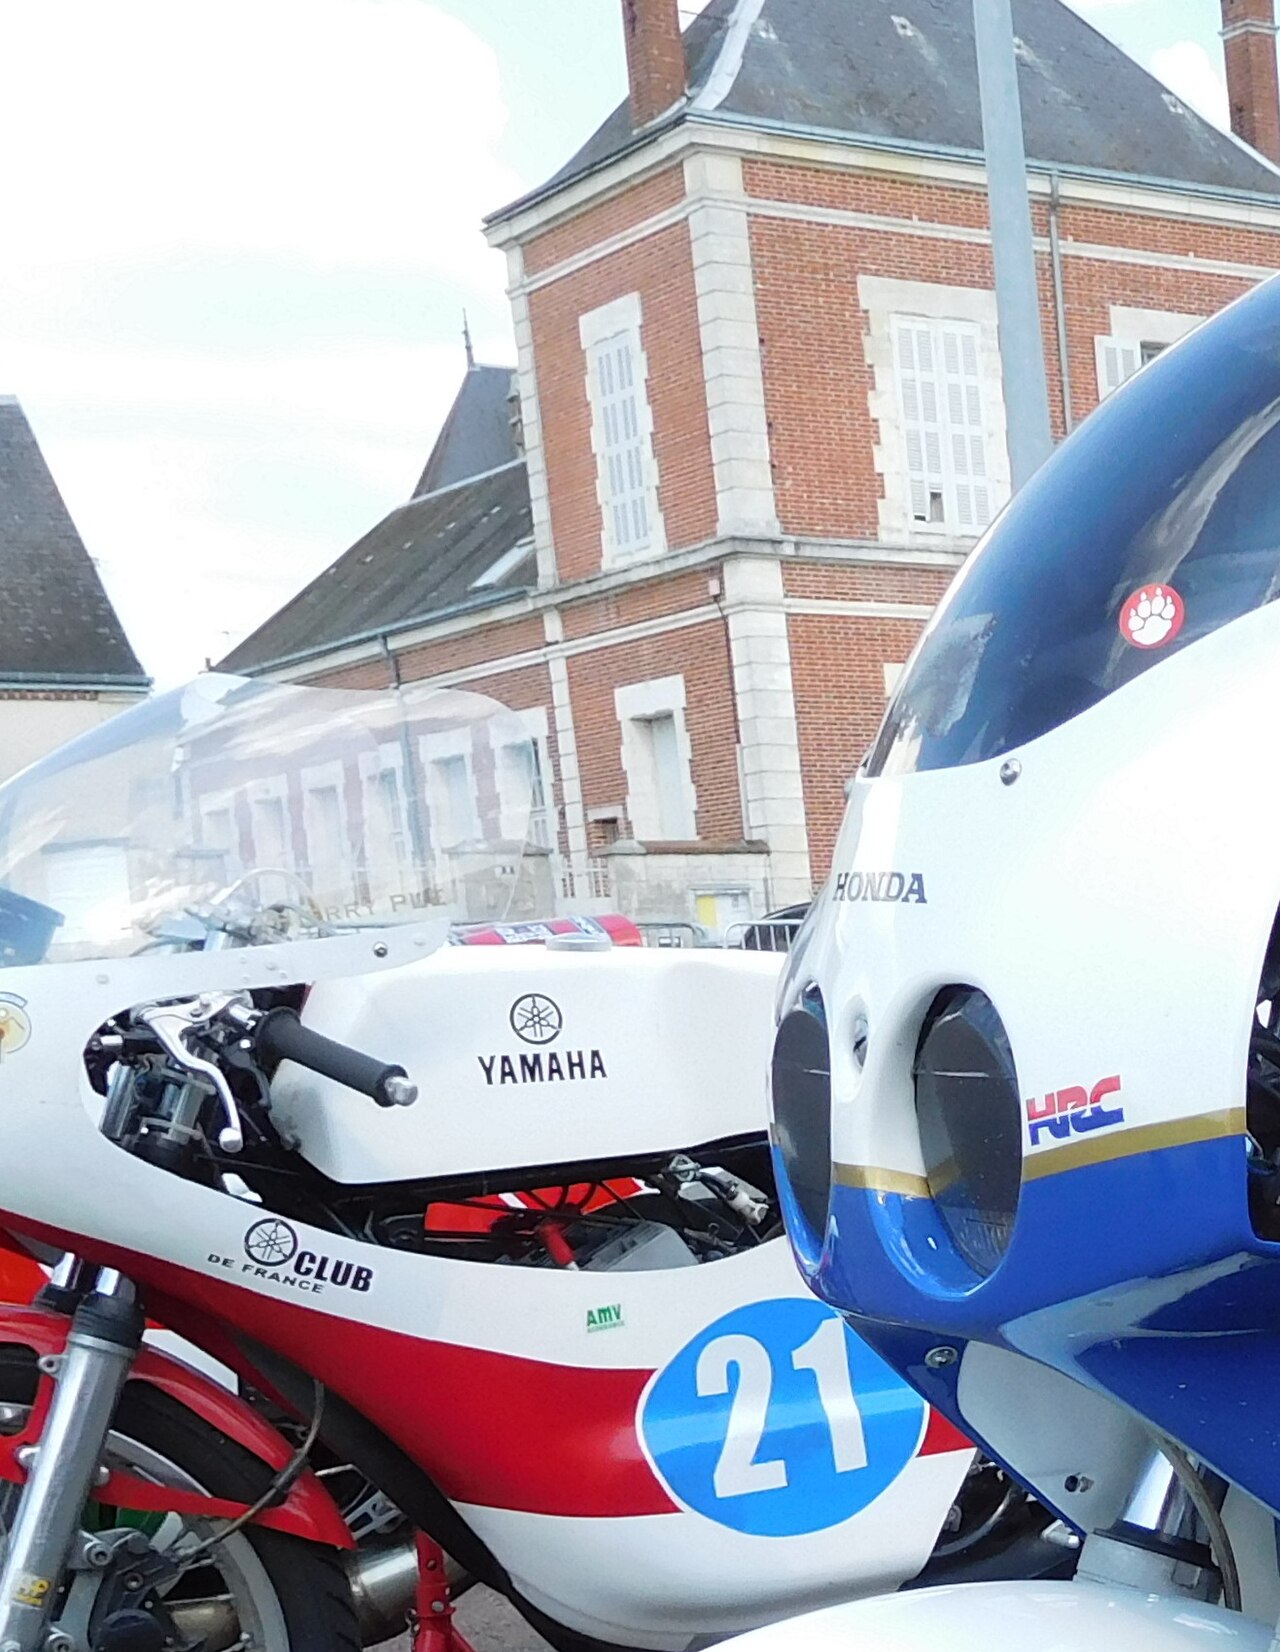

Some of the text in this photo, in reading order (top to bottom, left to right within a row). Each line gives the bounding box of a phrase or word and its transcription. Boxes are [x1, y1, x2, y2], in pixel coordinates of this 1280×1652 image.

[832, 871, 928, 904] HONDA
[478, 1049, 607, 1085] YAMAHA
[1026, 1075, 1124, 1146] HRC
[207, 1253, 325, 1294] DE FRANCE
[294, 1251, 373, 1292] CLUB
[696, 1317, 867, 1498] 21
